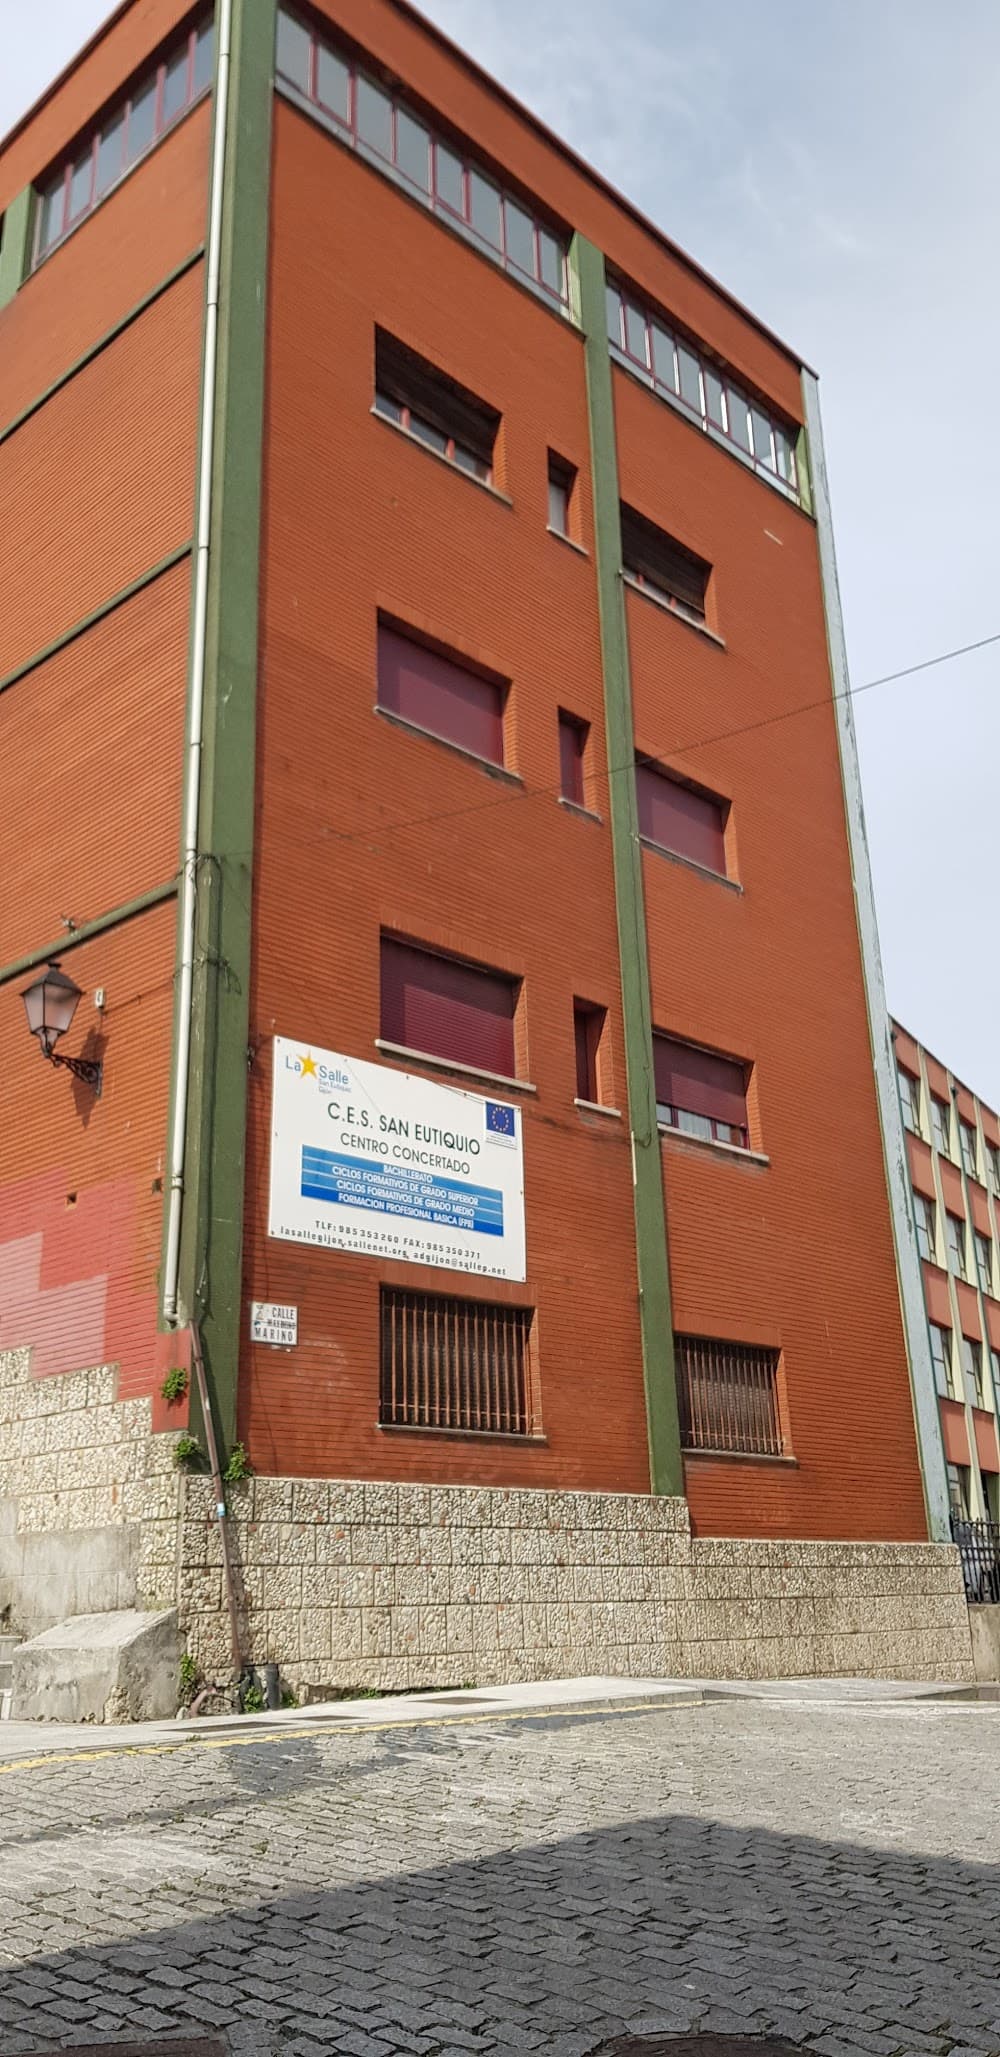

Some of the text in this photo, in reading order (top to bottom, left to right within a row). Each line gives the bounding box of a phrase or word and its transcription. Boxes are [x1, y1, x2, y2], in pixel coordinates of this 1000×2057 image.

[285, 1055, 349, 1085] La Salle
[327, 1102, 374, 1129] C.E.S.
[379, 1114, 409, 1137] SAN
[415, 1124, 481, 1155] EUTIQUIO
[340, 1132, 471, 1175] CENTRO CONCERTADO
[332, 1166, 479, 1206] CICLOS FORMATIVOS DE GRADO SUPERIOR
[383, 1164, 433, 1183] BACHILLERATO
[336, 1180, 475, 1218] CICLOS FORMATIVOS DE GRADO MEDIO
[338, 1192, 386, 1211] FORMACION
[386, 1202, 432, 1220] PROFESIONAL
[433, 1210, 458, 1225] BASICA
[272, 1307, 295, 1320] CALLE
